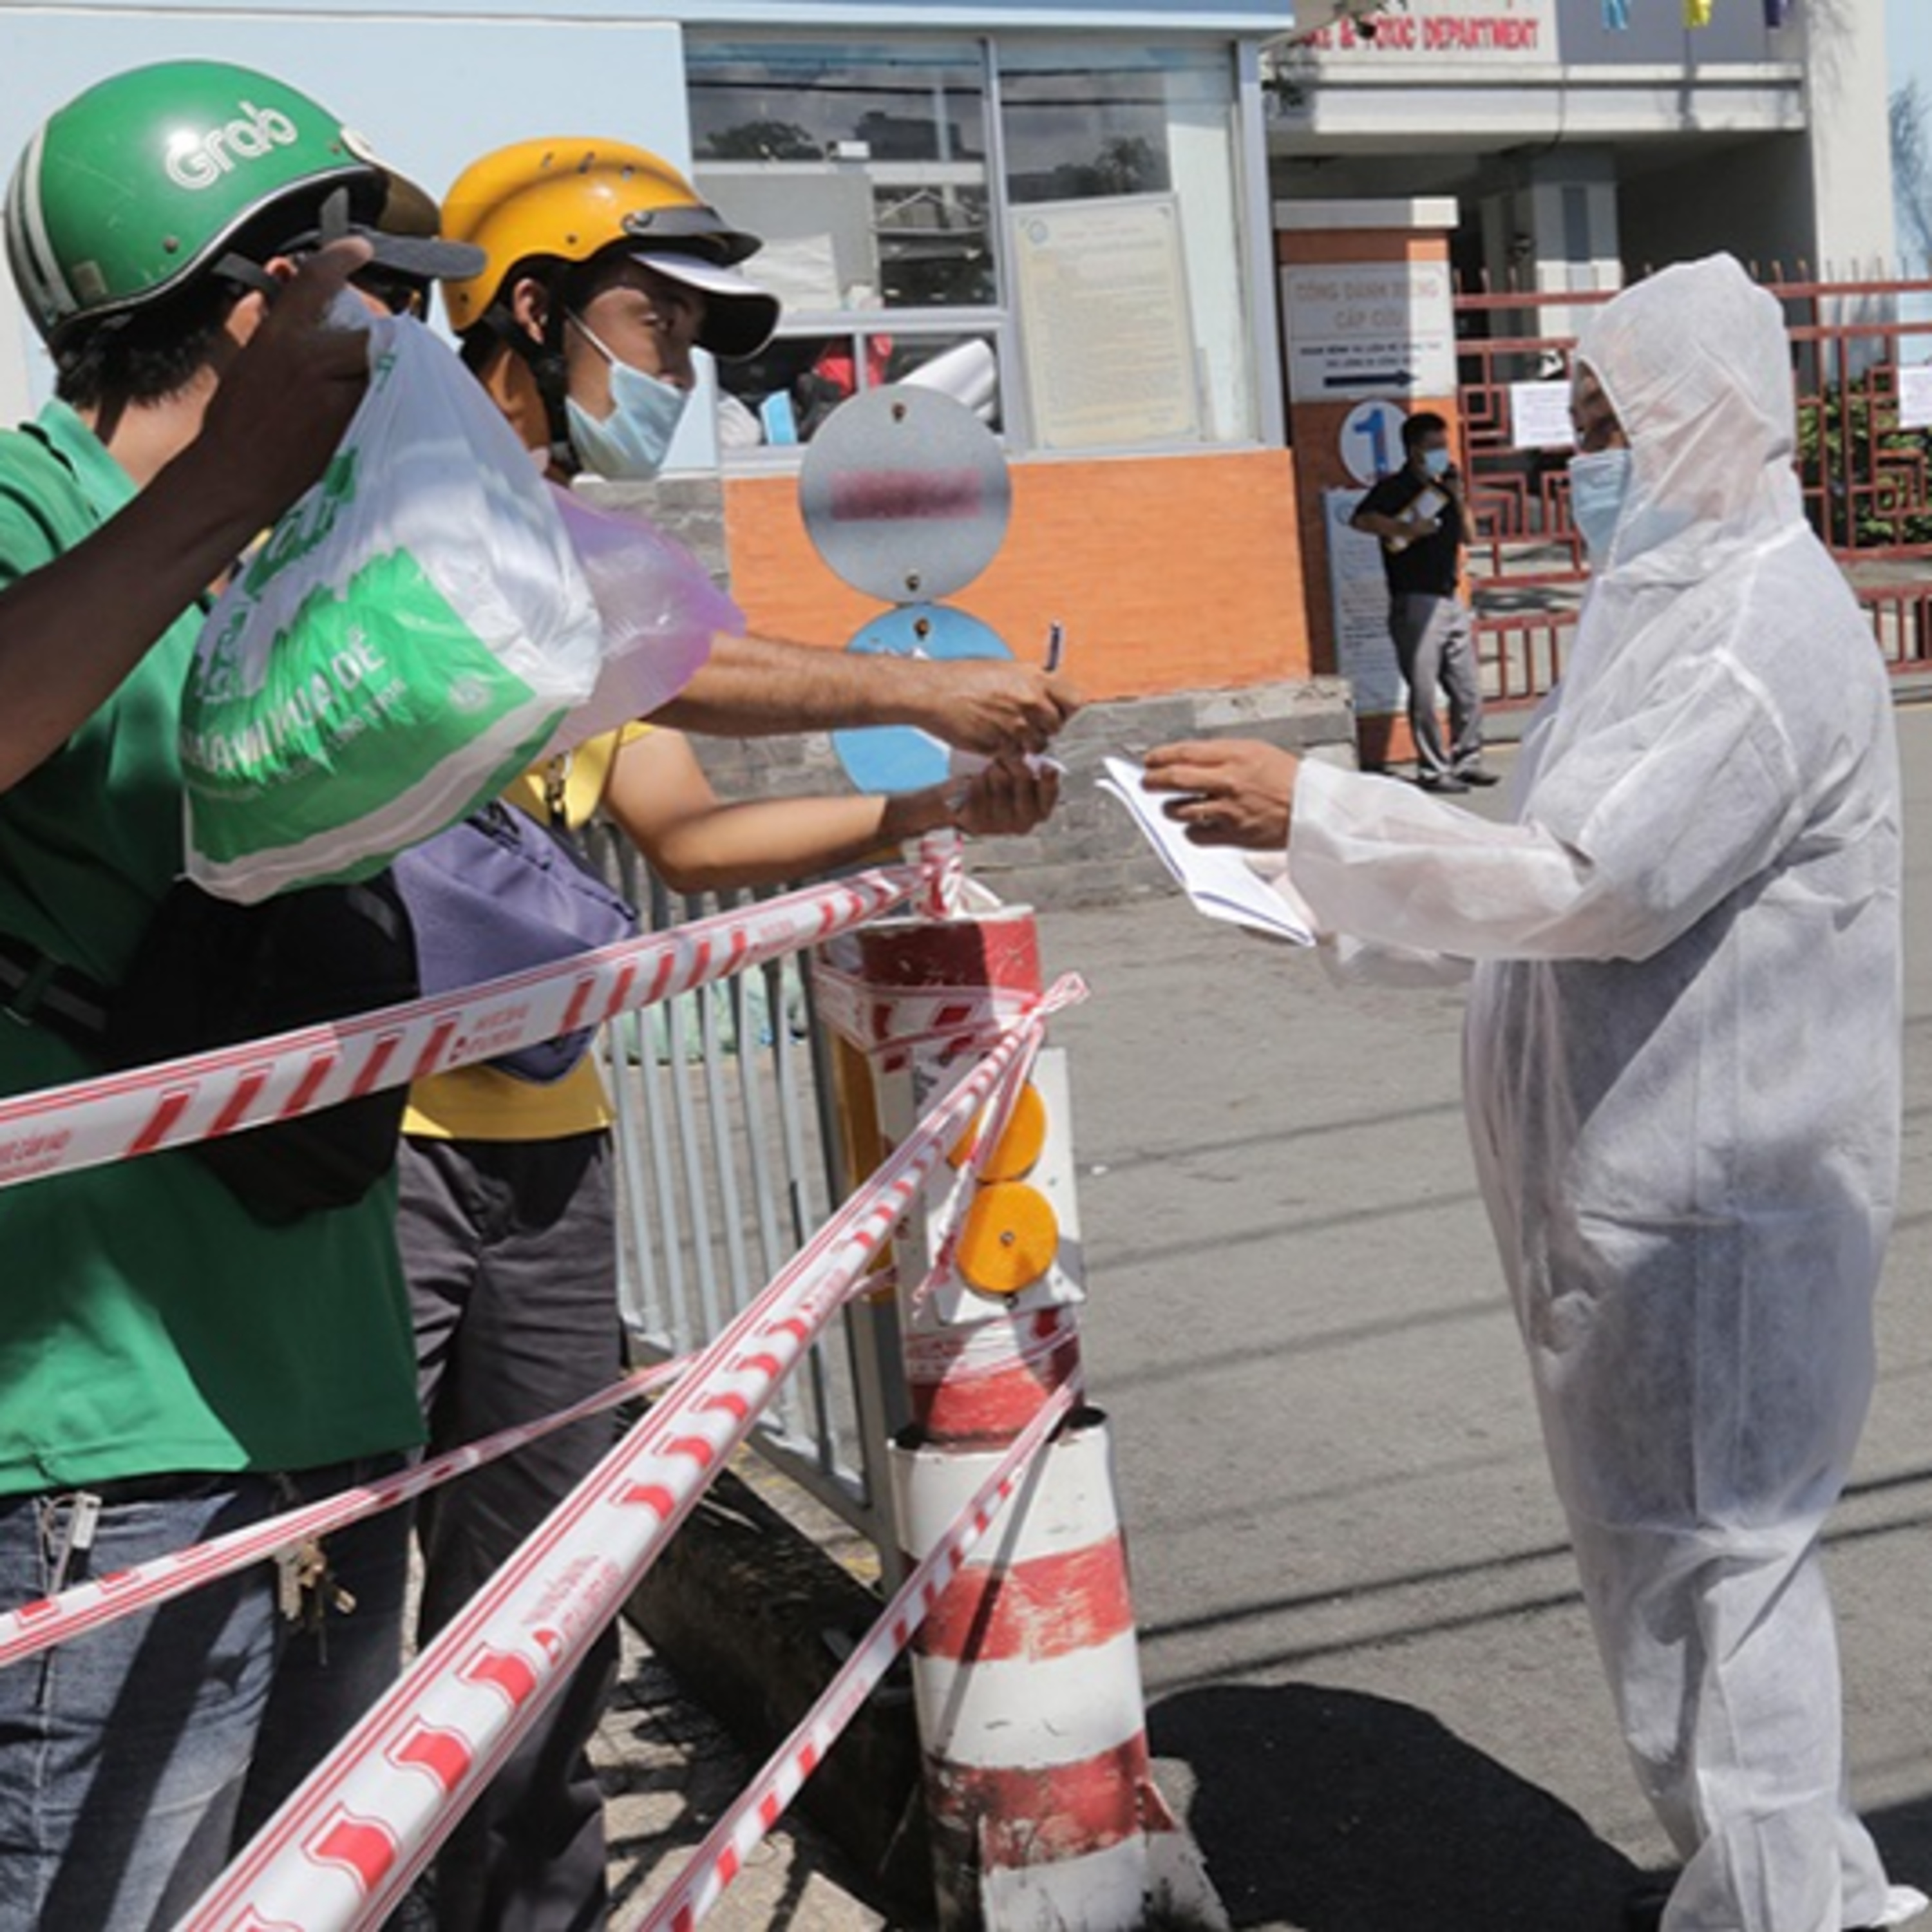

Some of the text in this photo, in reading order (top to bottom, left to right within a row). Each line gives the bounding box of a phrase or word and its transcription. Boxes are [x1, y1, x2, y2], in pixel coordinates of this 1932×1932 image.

[1423, 17, 1539, 50] DEPARTMENT
[165, 101, 298, 190] Grab
[1354, 408, 1388, 478] 1
